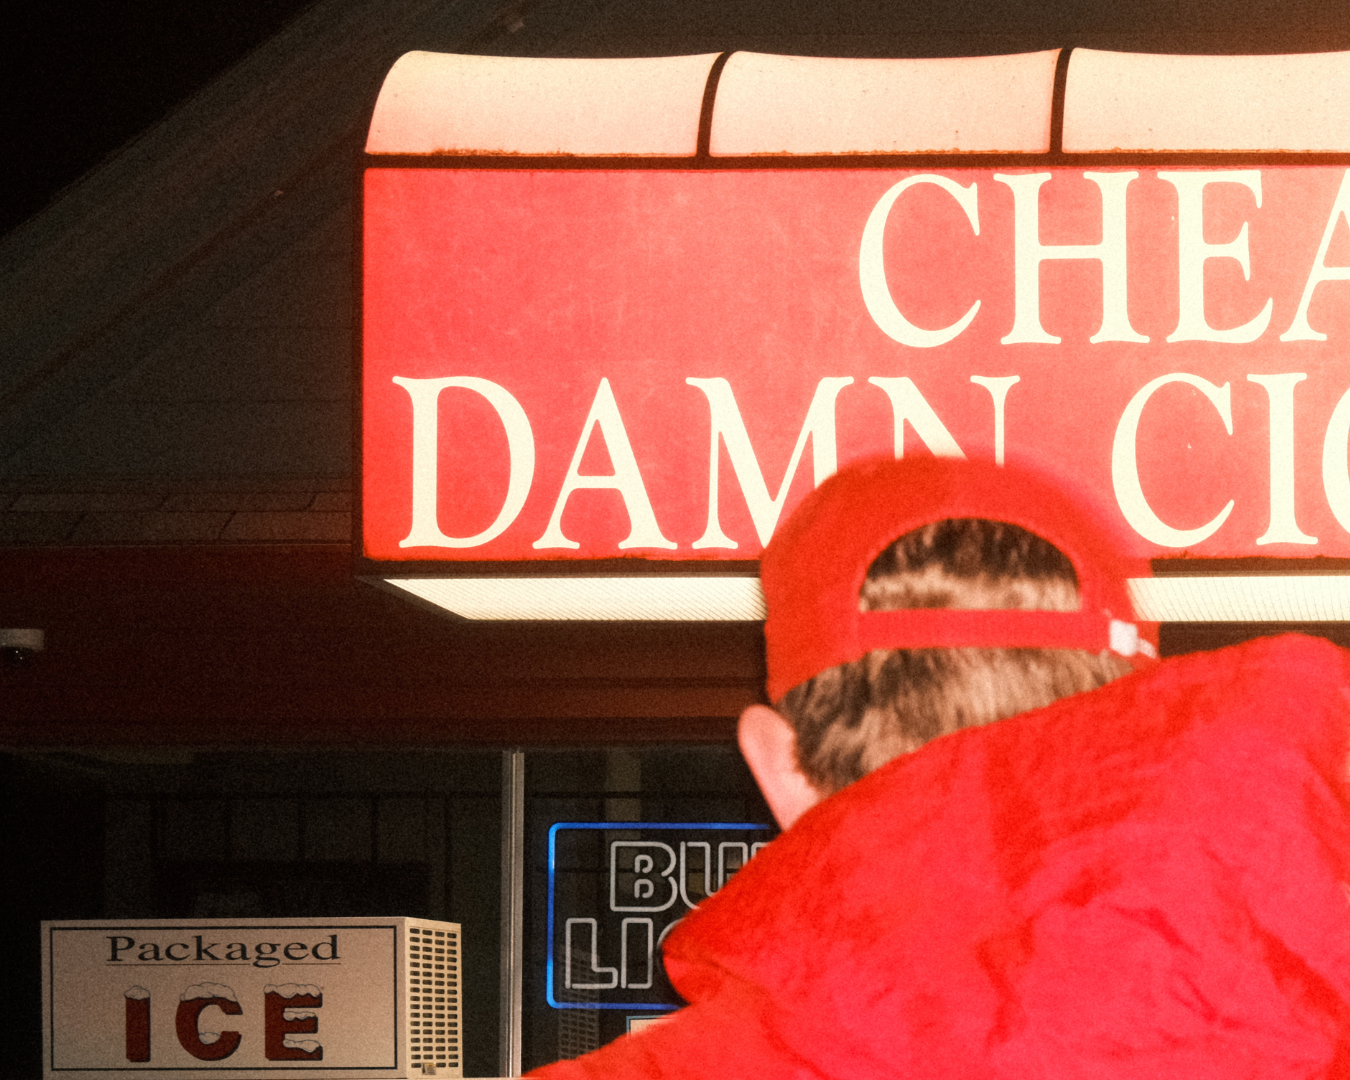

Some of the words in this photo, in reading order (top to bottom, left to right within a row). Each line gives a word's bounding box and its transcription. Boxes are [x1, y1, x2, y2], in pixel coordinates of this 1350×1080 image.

[610, 840, 770, 912] BU
[106, 934, 341, 969] Packaged
[124, 982, 323, 1062] ICE
